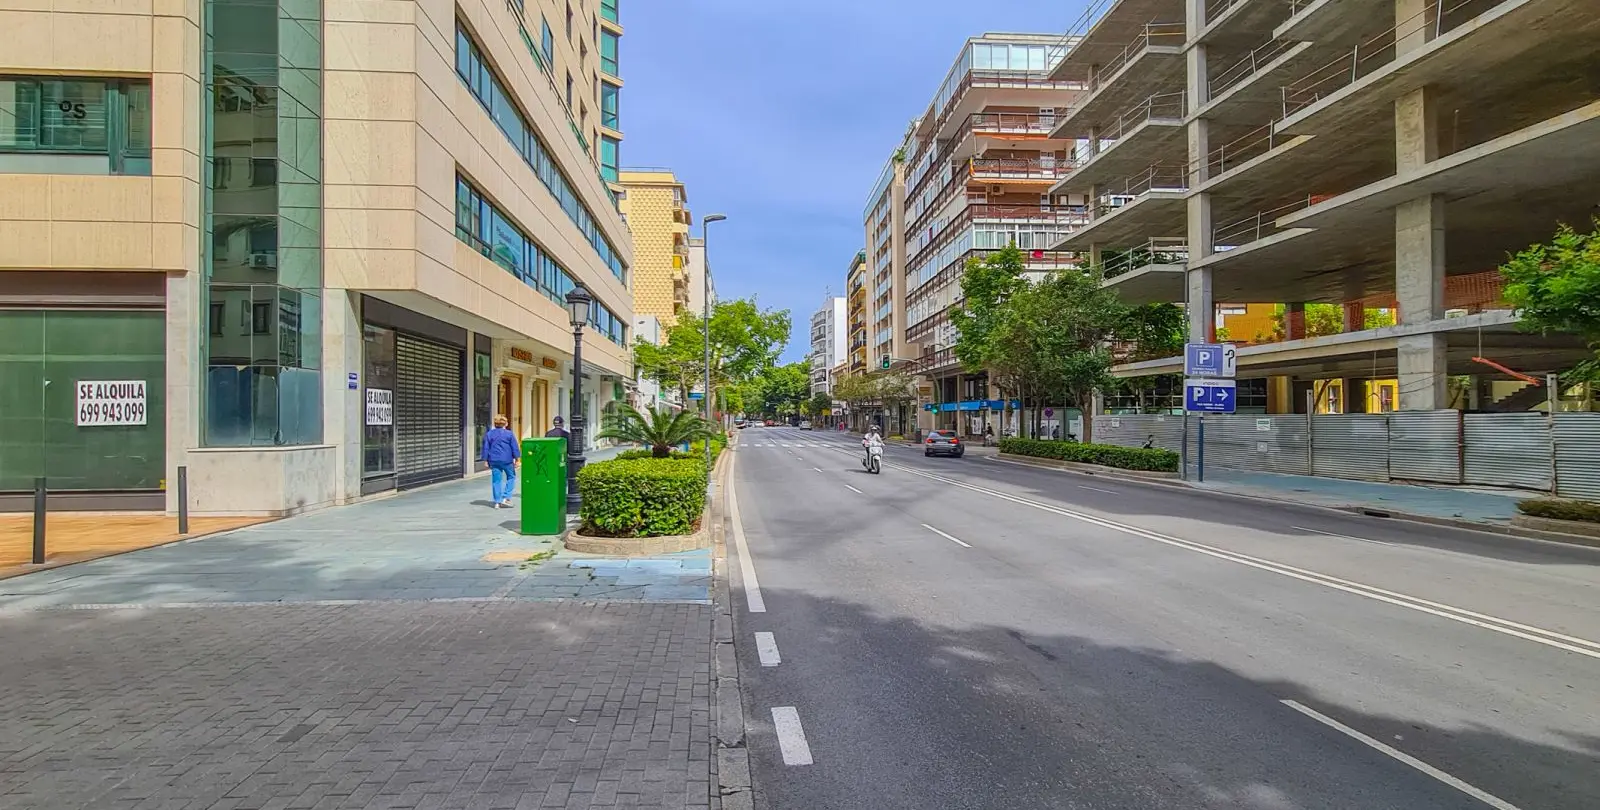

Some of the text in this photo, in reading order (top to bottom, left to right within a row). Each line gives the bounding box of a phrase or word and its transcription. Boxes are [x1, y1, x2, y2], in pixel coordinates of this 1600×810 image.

[1199, 351, 1211, 365] P
[80, 384, 144, 400] SE ALQUILA
[367, 391, 373, 404] SE
[1193, 387, 1205, 402] P
[80, 403, 144, 422] 699 943 099
